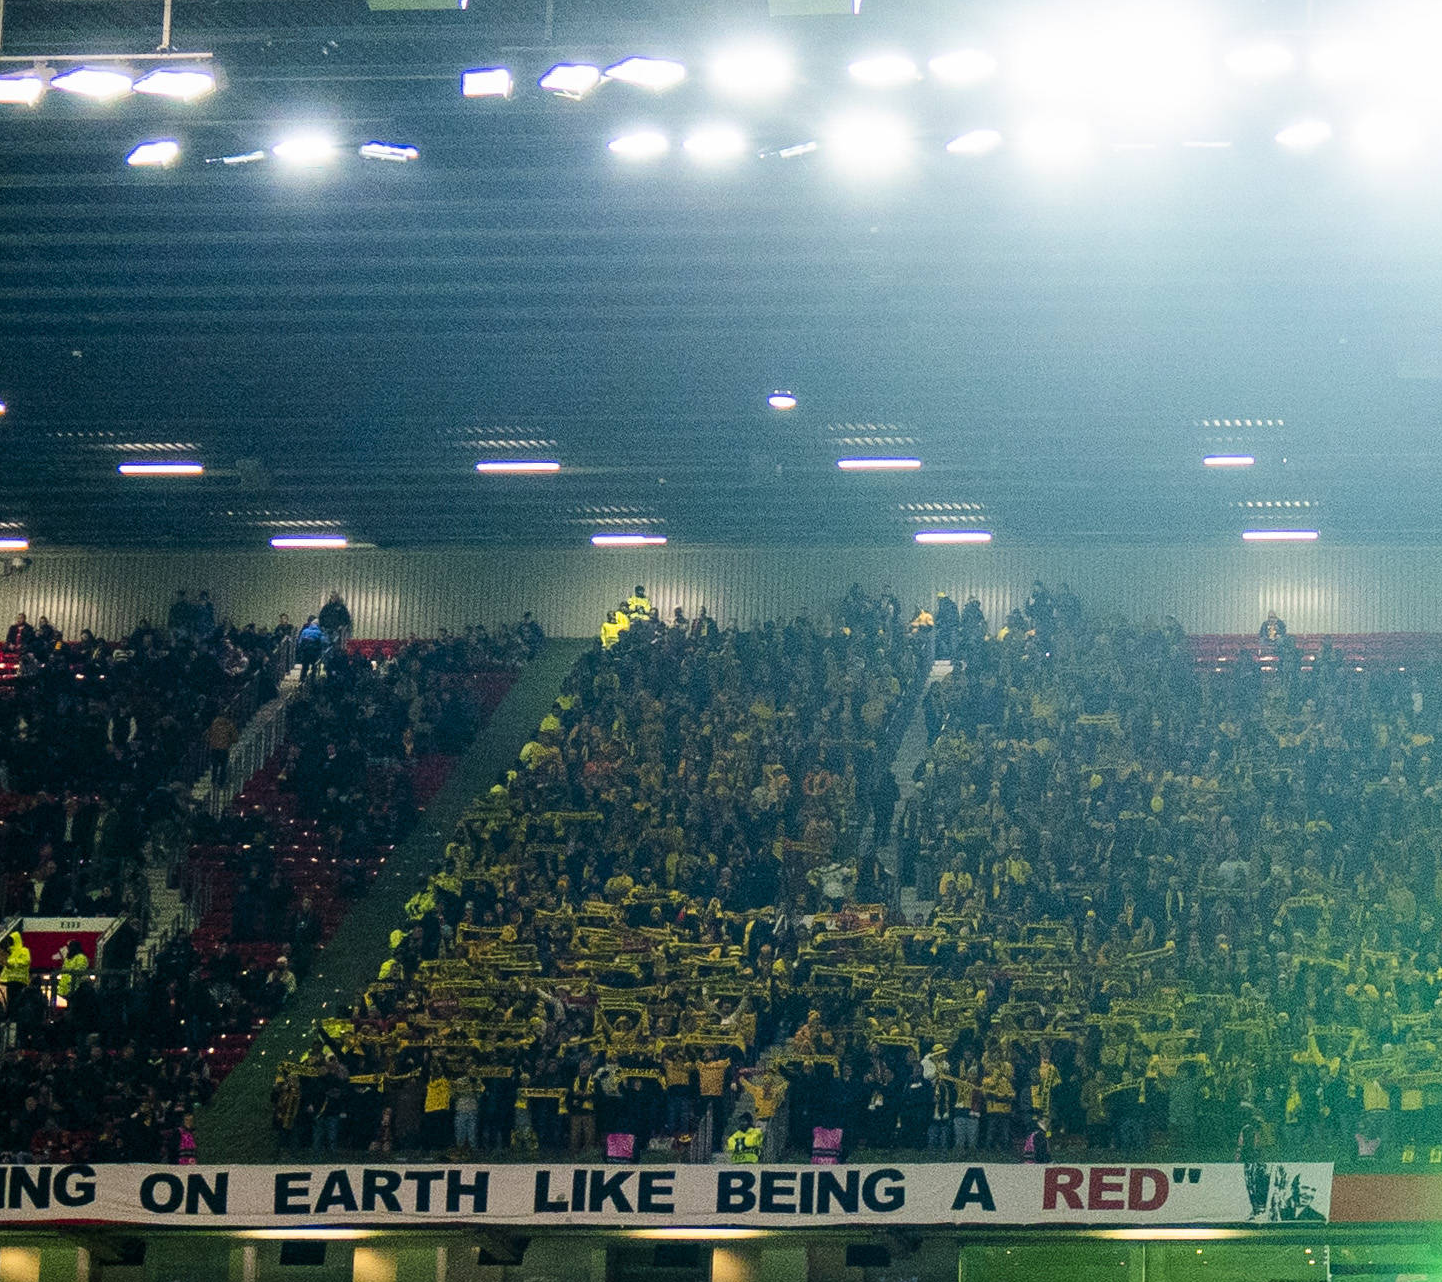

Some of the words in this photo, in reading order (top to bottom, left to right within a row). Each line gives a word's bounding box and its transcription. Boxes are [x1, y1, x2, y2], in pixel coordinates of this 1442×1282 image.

[139, 1172, 229, 1216] ON
[273, 1168, 490, 1215] EARTH
[533, 1168, 676, 1215] LIKE
[716, 1168, 907, 1215] BEING
[952, 1167, 996, 1211] A
[1041, 1166, 1203, 1213] RED"
